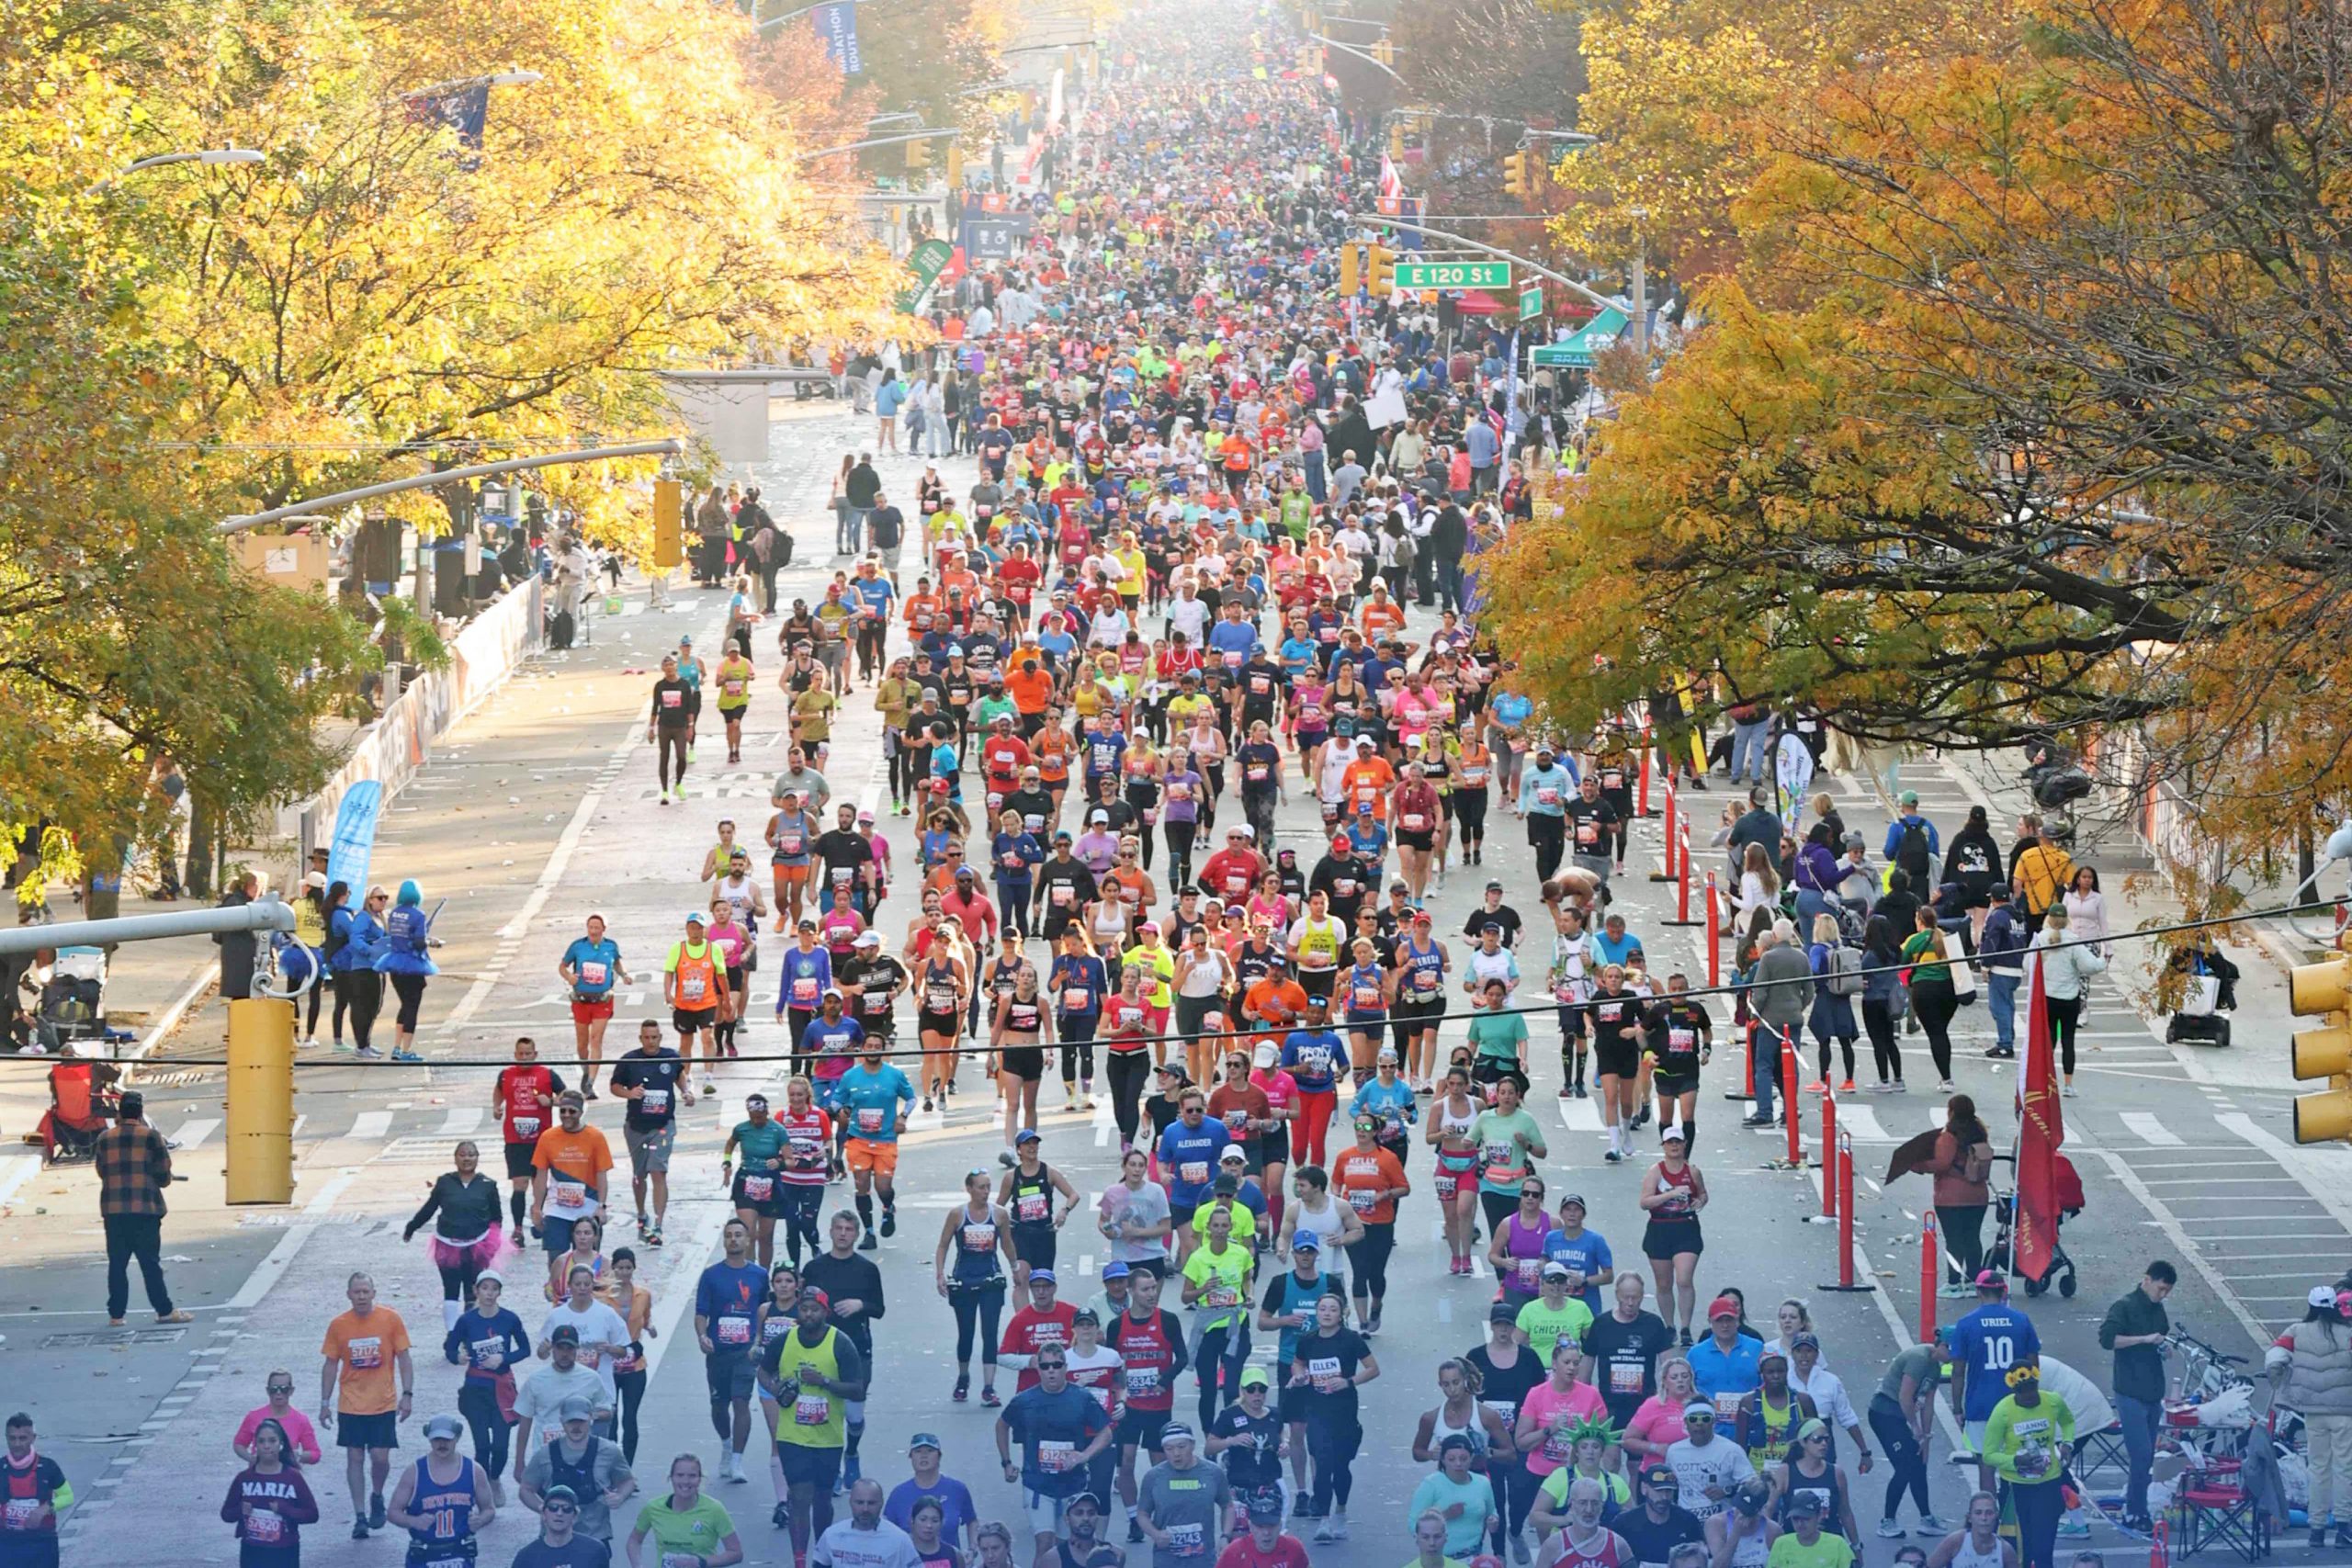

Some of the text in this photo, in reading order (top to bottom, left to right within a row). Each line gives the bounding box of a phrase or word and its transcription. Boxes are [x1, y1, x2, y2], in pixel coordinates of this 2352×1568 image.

[847, 32, 860, 72] ROUTE
[1412, 267, 1492, 283] E 120 St
[1093, 743, 1117, 752] 26.2
[1177, 1138, 1212, 1148] ALEXANDER
[1350, 1157, 1377, 1166] KELLY
[1554, 1250, 1586, 1261] PATRICIA
[1980, 1317, 2013, 1327] URIEL
[351, 1345, 379, 1357] 57172
[1984, 1336, 2013, 1370] 10
[1312, 1360, 1337, 1371] ELLEN
[1127, 1376, 1158, 1386] 56343
[1612, 1372, 1643, 1382] 48861
[798, 1403, 827, 1415] 49814
[2016, 1419, 2048, 1432] DIANNE
[242, 1481, 298, 1500] MARIA
[248, 1517, 281, 1532] 57620
[435, 1509, 455, 1538] 11
